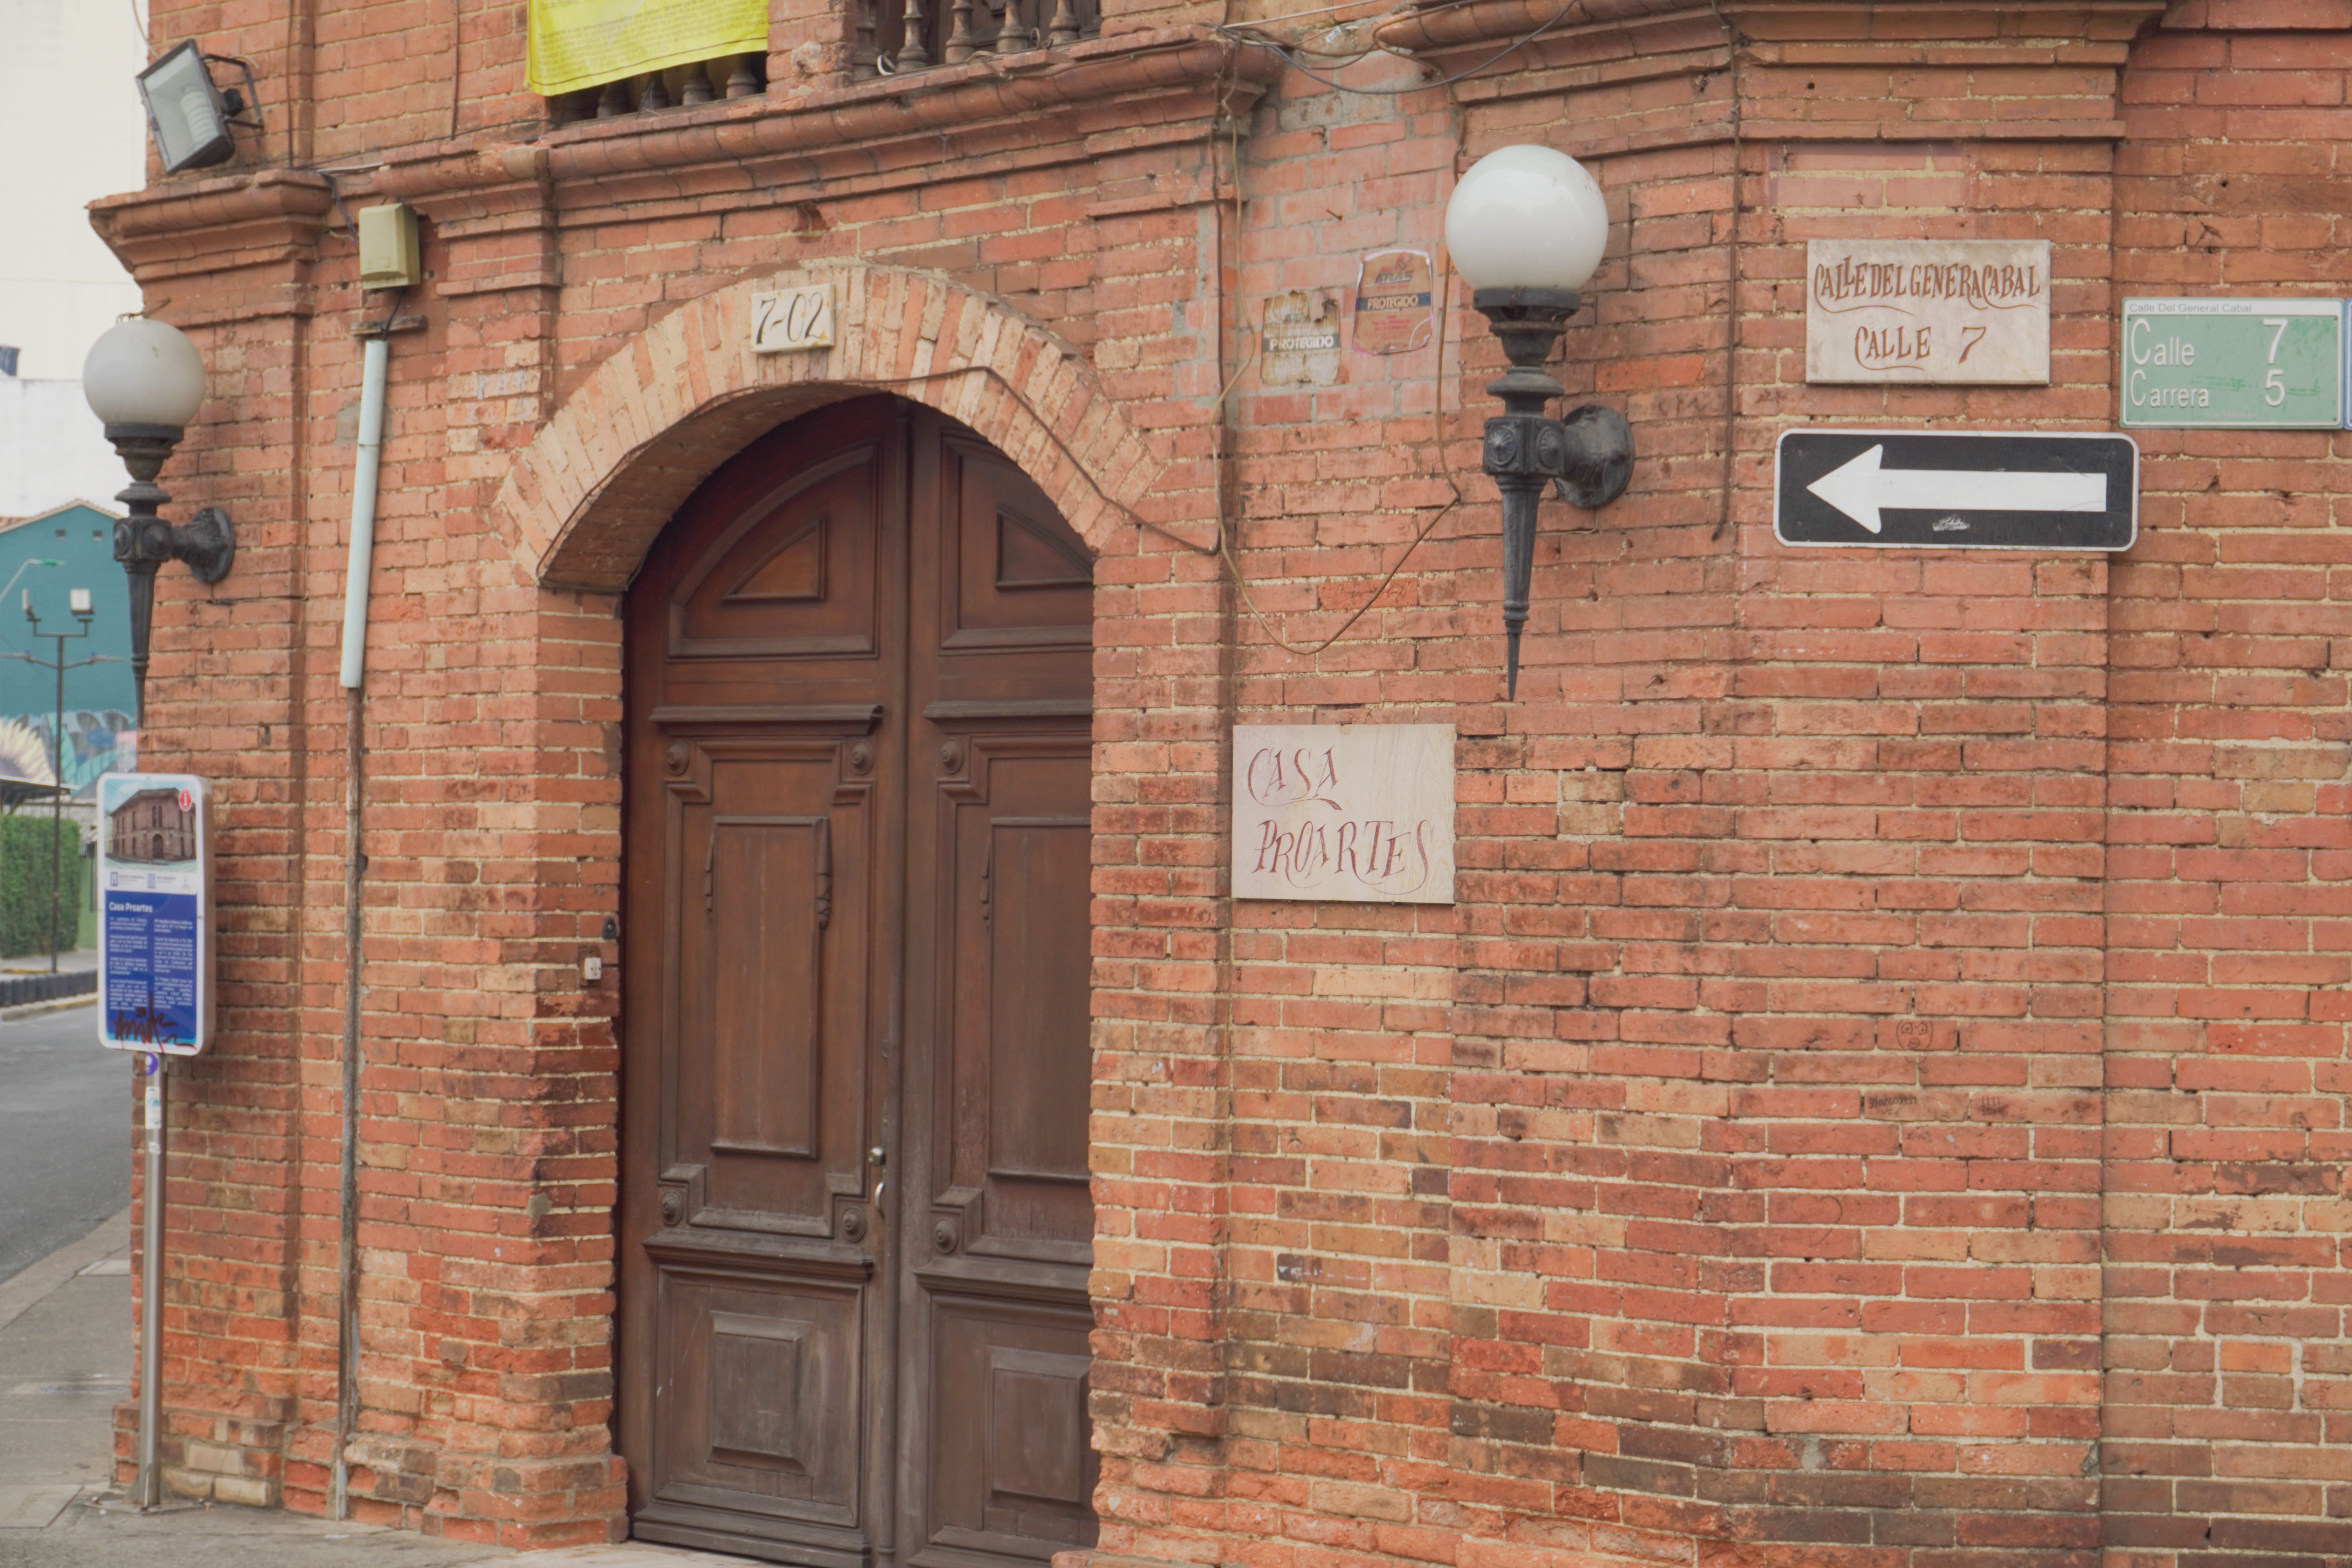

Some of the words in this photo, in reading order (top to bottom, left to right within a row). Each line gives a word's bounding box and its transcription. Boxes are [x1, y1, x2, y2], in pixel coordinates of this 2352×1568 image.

[1367, 294, 1419, 310] PROTEGIDO
[1814, 255, 1870, 313] CALLE
[1869, 263, 1907, 299] DEL
[1982, 265, 2040, 309] CABAL
[756, 292, 824, 345] 7-02
[2129, 303, 2155, 312] Calle
[2159, 303, 2175, 312] Del
[2178, 303, 2219, 312] General
[2222, 303, 2252, 312] Cabal
[1269, 334, 1334, 351] PROTEGIDO
[1855, 325, 1931, 370] CALLE
[1958, 326, 1987, 364] 7
[2131, 318, 2195, 367] Calle
[2263, 319, 2288, 365] 7
[2130, 369, 2209, 407] Carrera
[2265, 369, 2286, 407] 5
[1248, 745, 1342, 811] CASA
[1252, 819, 1435, 895] PROARTES
[109, 902, 124, 911] Casa
[125, 902, 153, 913] Proartes
